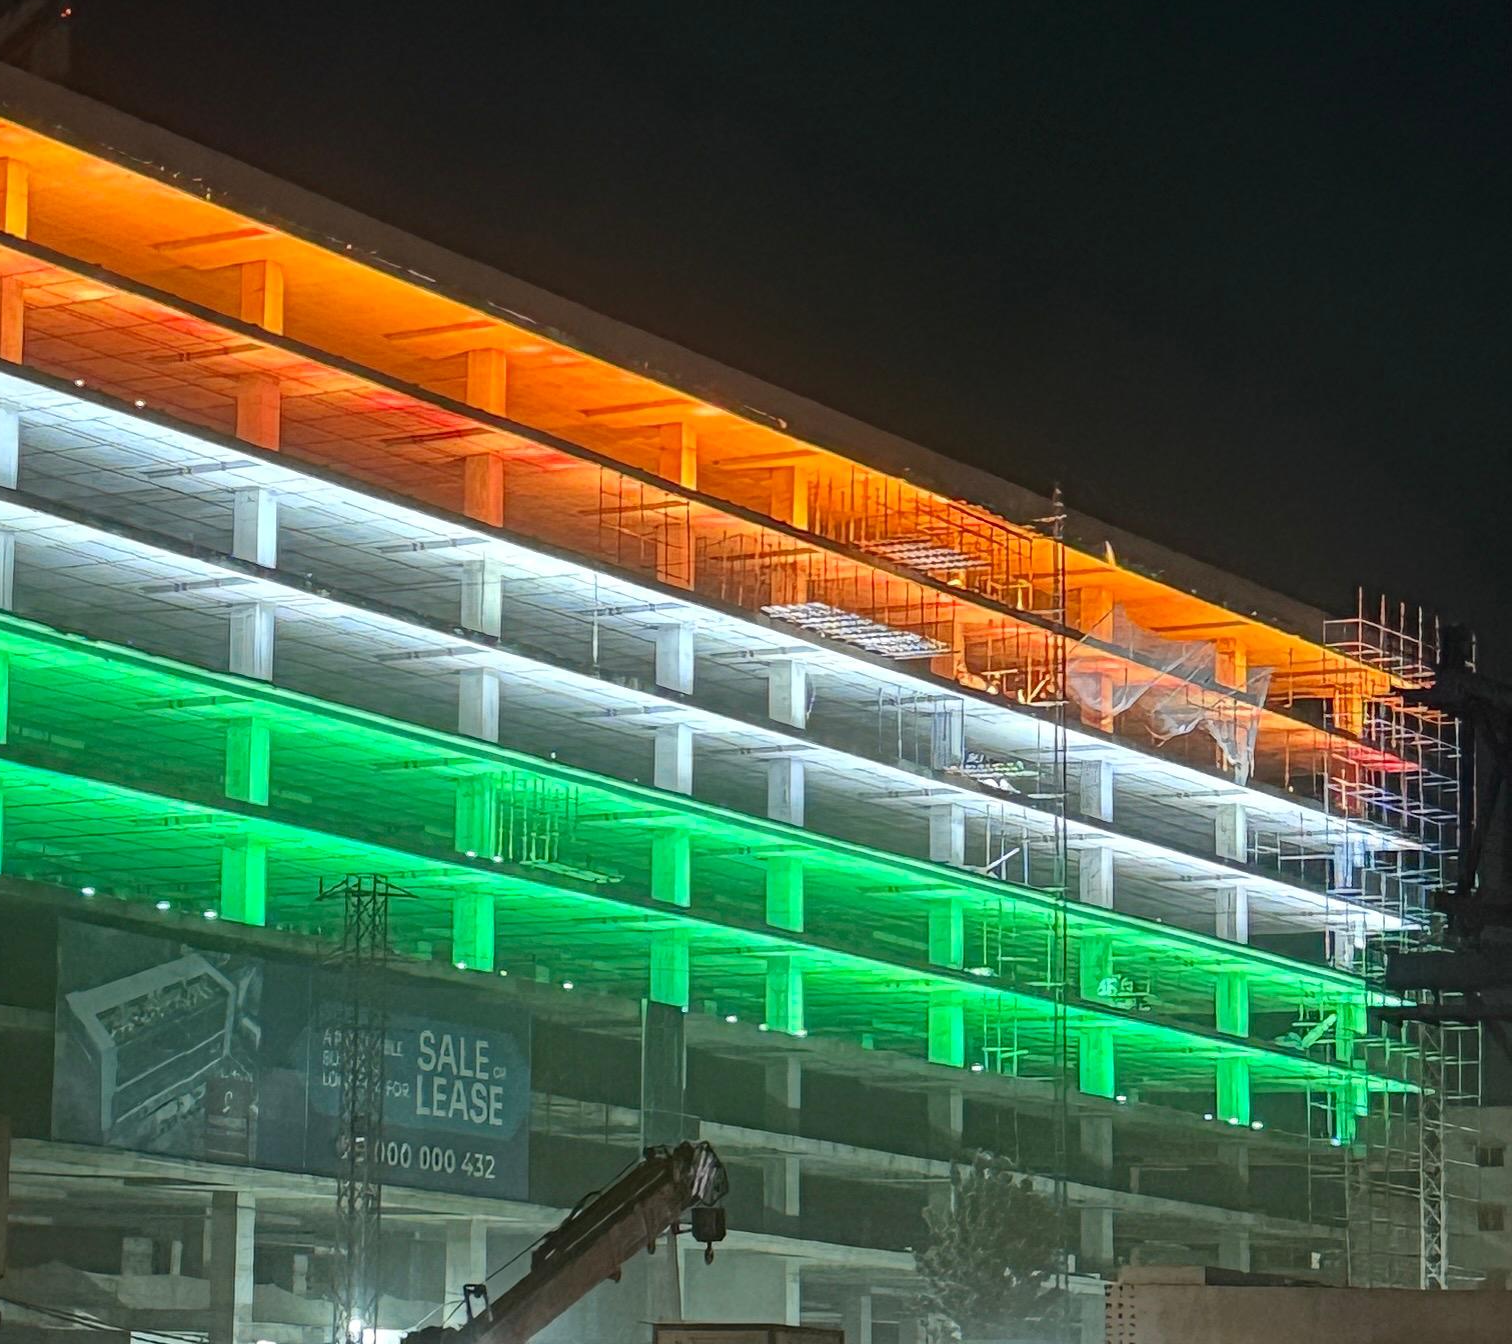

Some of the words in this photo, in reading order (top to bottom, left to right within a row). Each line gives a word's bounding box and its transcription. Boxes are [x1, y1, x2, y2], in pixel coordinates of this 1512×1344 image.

[416, 1029, 490, 1080] SALE
[415, 1073, 504, 1126] LEASE
[419, 1144, 456, 1174] 000
[460, 1151, 497, 1180] 432
